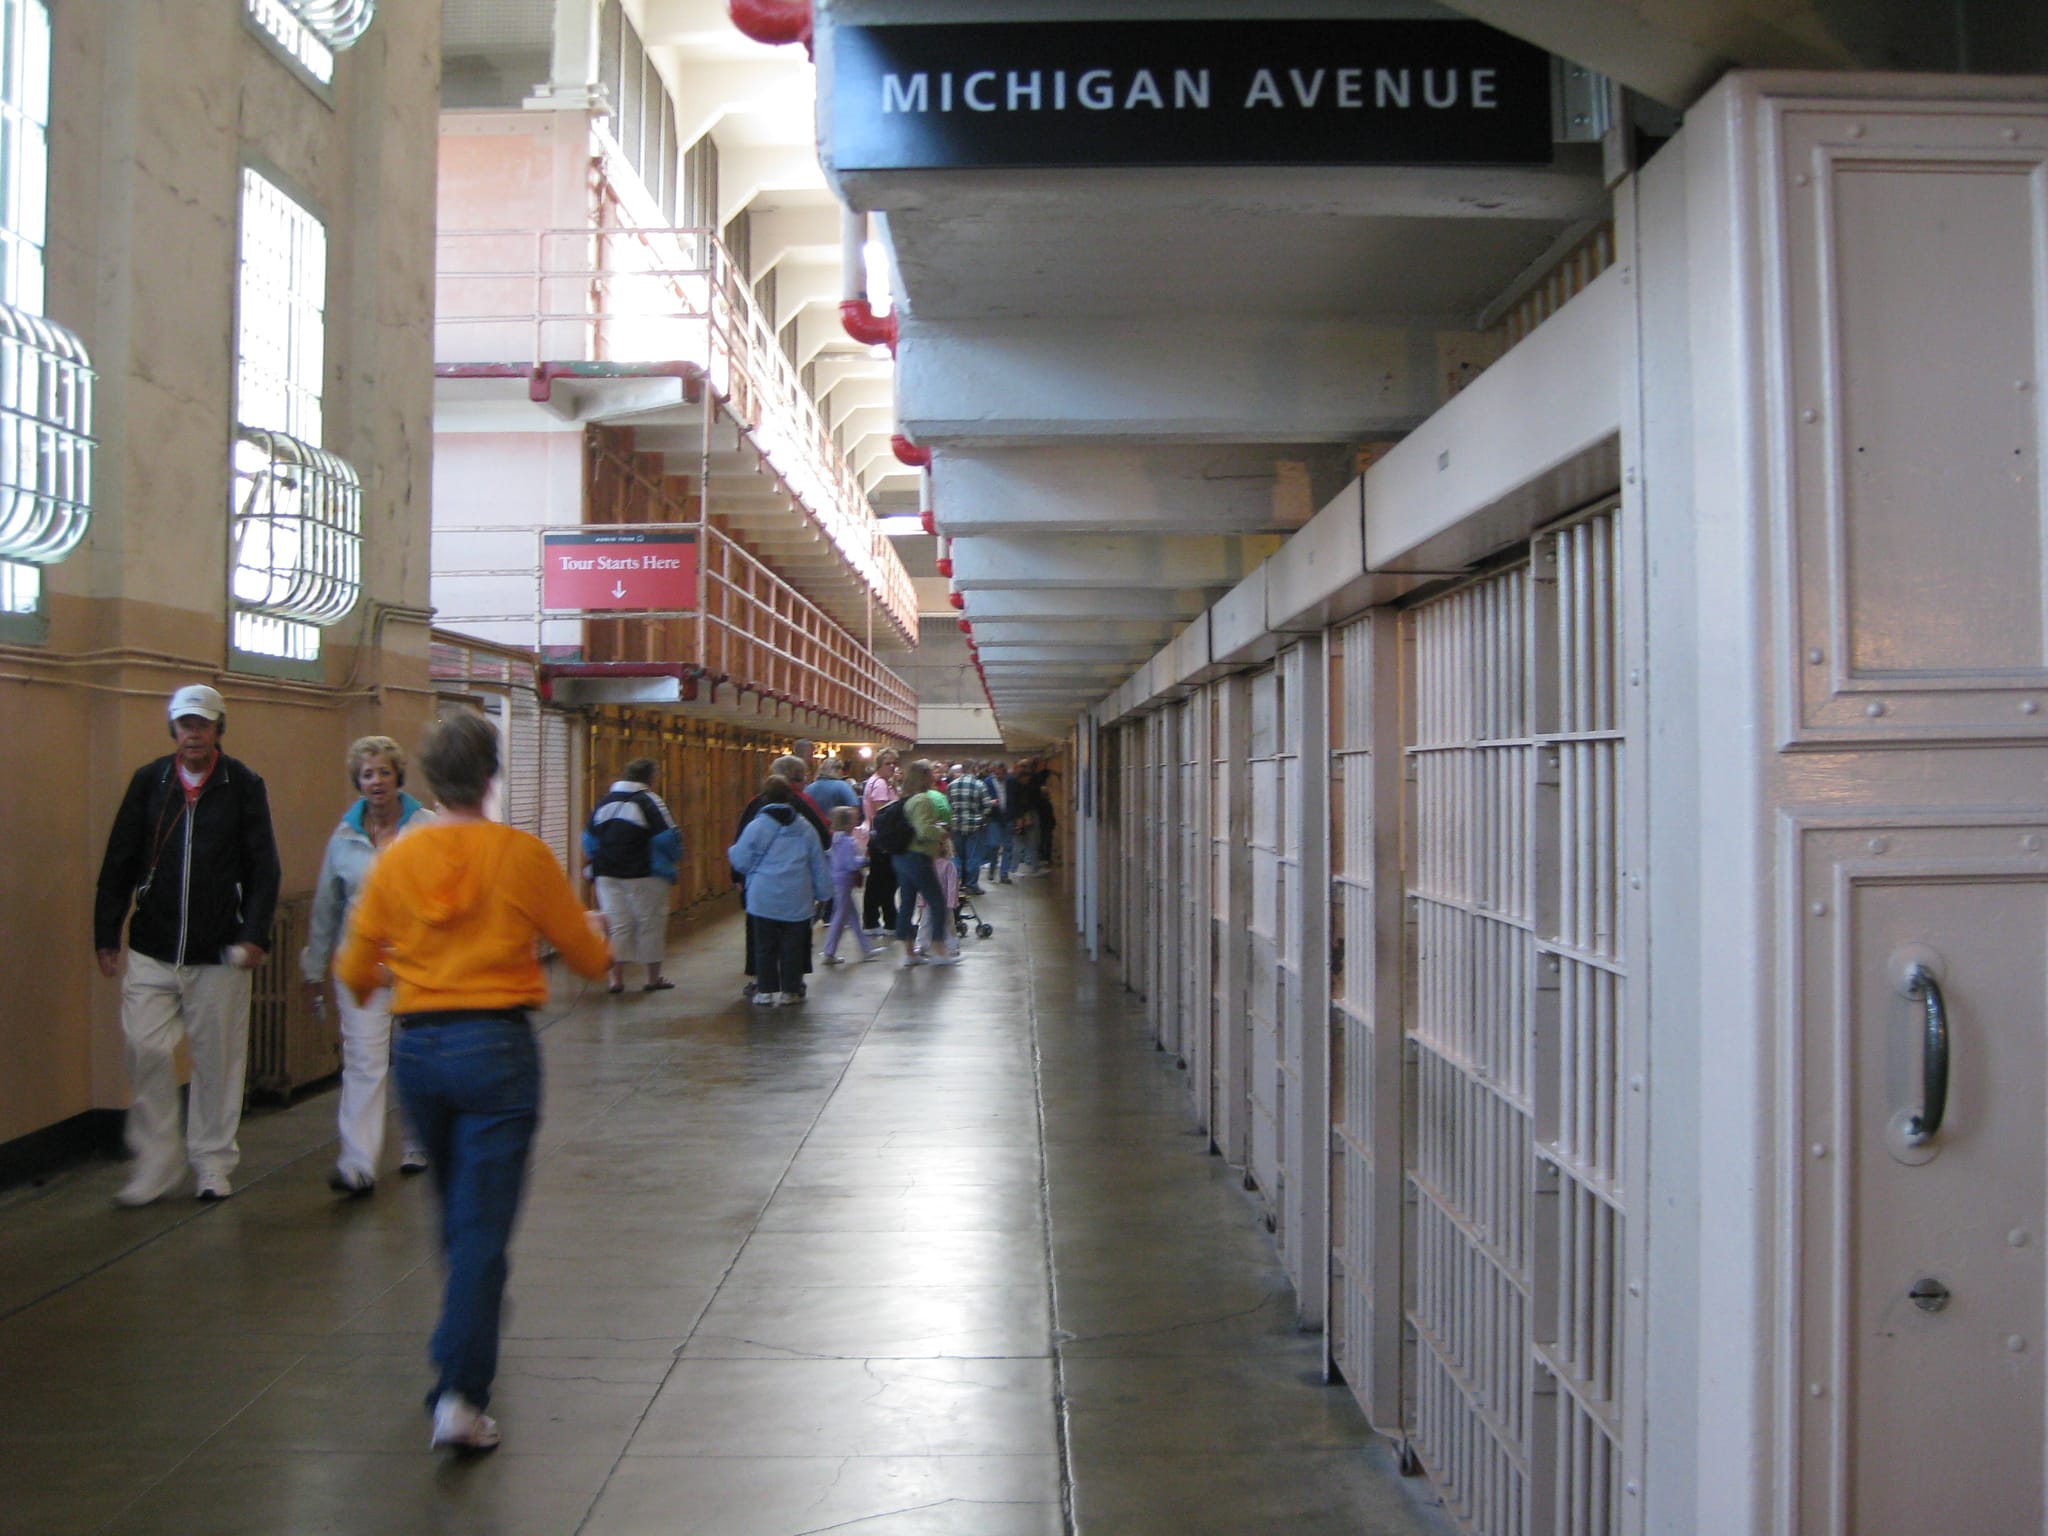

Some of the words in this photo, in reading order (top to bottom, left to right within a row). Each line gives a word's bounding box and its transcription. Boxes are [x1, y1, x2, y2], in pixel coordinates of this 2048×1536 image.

[881, 68, 1211, 113] MICHIGAN
[1243, 66, 1498, 110] AVENUE
[559, 556, 596, 570] Tour
[597, 555, 641, 570] Starts
[642, 555, 681, 570] Here
